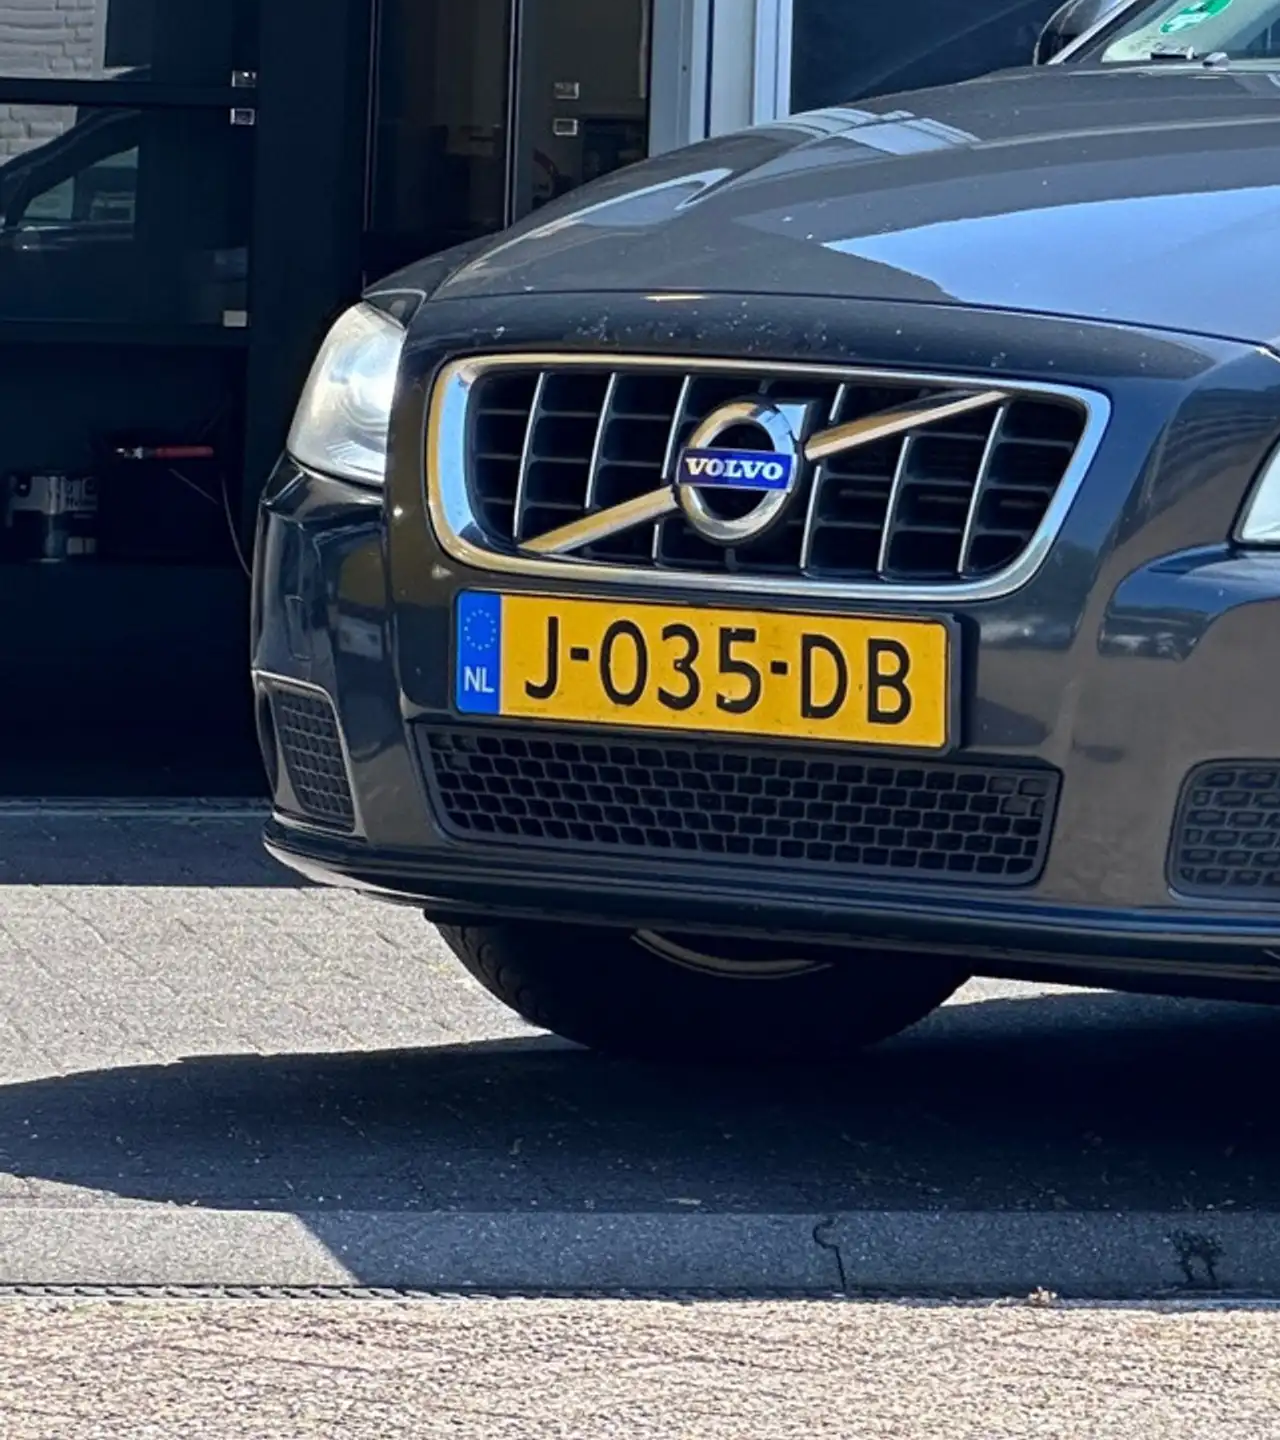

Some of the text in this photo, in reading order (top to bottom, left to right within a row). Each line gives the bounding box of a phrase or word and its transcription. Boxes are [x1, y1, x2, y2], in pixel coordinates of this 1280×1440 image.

[684, 457, 784, 481] VOLVO
[463, 665, 495, 695] NL
[524, 615, 913, 725] J-035-DB
